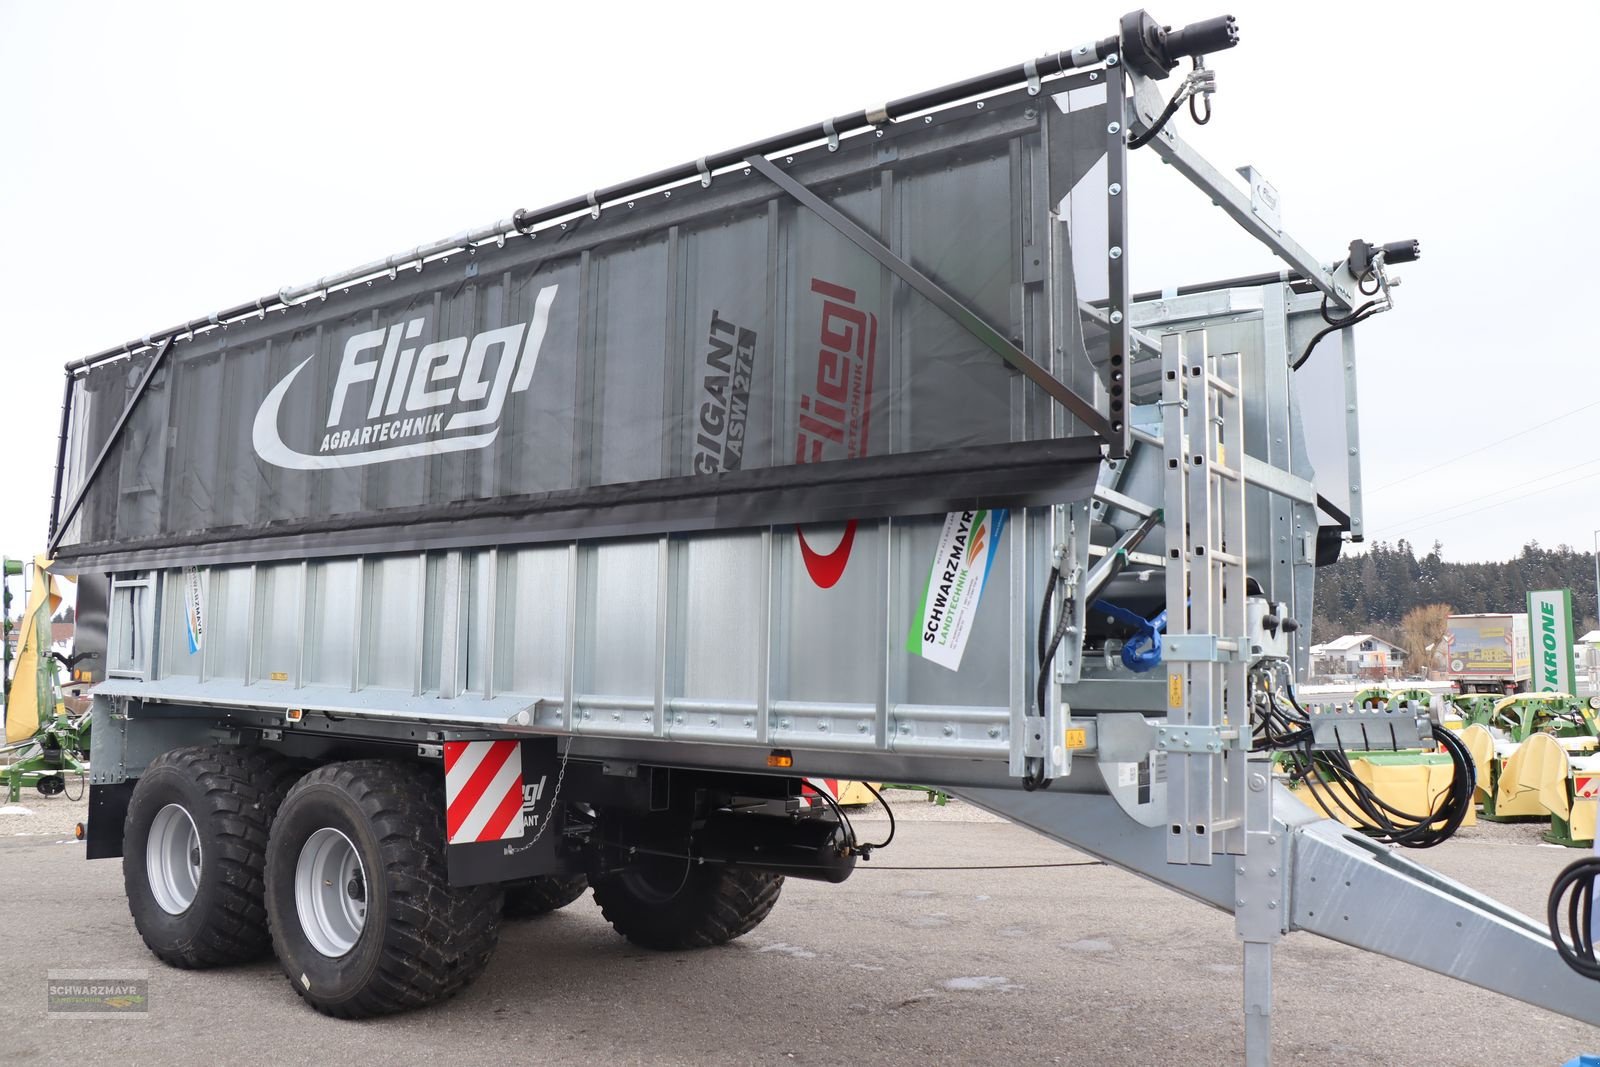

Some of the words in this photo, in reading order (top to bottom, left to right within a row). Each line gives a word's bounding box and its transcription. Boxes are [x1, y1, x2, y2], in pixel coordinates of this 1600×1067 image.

[326, 284, 559, 430] Fliegl
[693, 309, 736, 475] GIGANT
[735, 345, 754, 393] 271
[319, 412, 444, 452] AGRARTECHNIK
[727, 394, 747, 458] ASW
[924, 510, 975, 644] SCHWARZMAYR
[938, 568, 969, 646] LANDTECHNIK
[1541, 600, 1558, 685] KRONE
